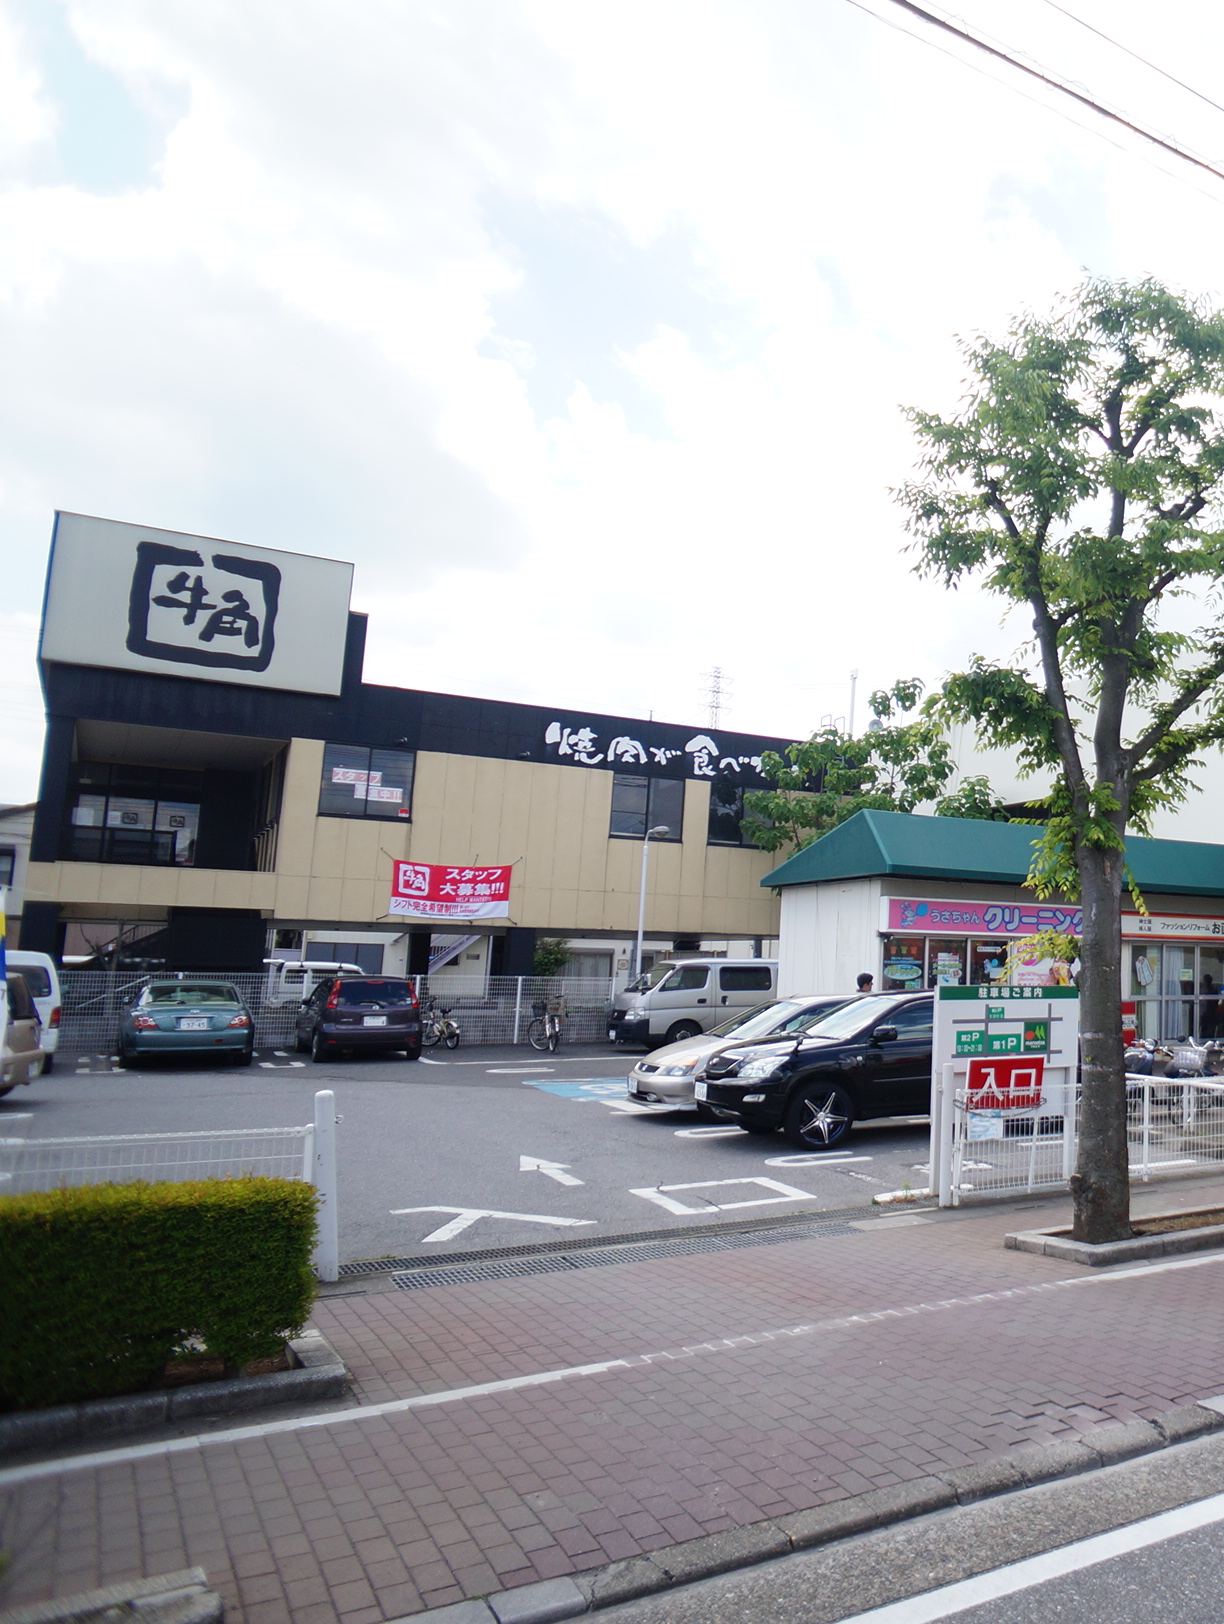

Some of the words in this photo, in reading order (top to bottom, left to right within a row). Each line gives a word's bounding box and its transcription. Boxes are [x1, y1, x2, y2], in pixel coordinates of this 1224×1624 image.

[151, 571, 260, 648] 牛角
[333, 771, 381, 784] スタッフ
[445, 868, 502, 880] スタッフ
[930, 909, 980, 925] うさちゃん
[978, 987, 1043, 998] 駐車場ご案内
[971, 1067, 1037, 1102] 入口
